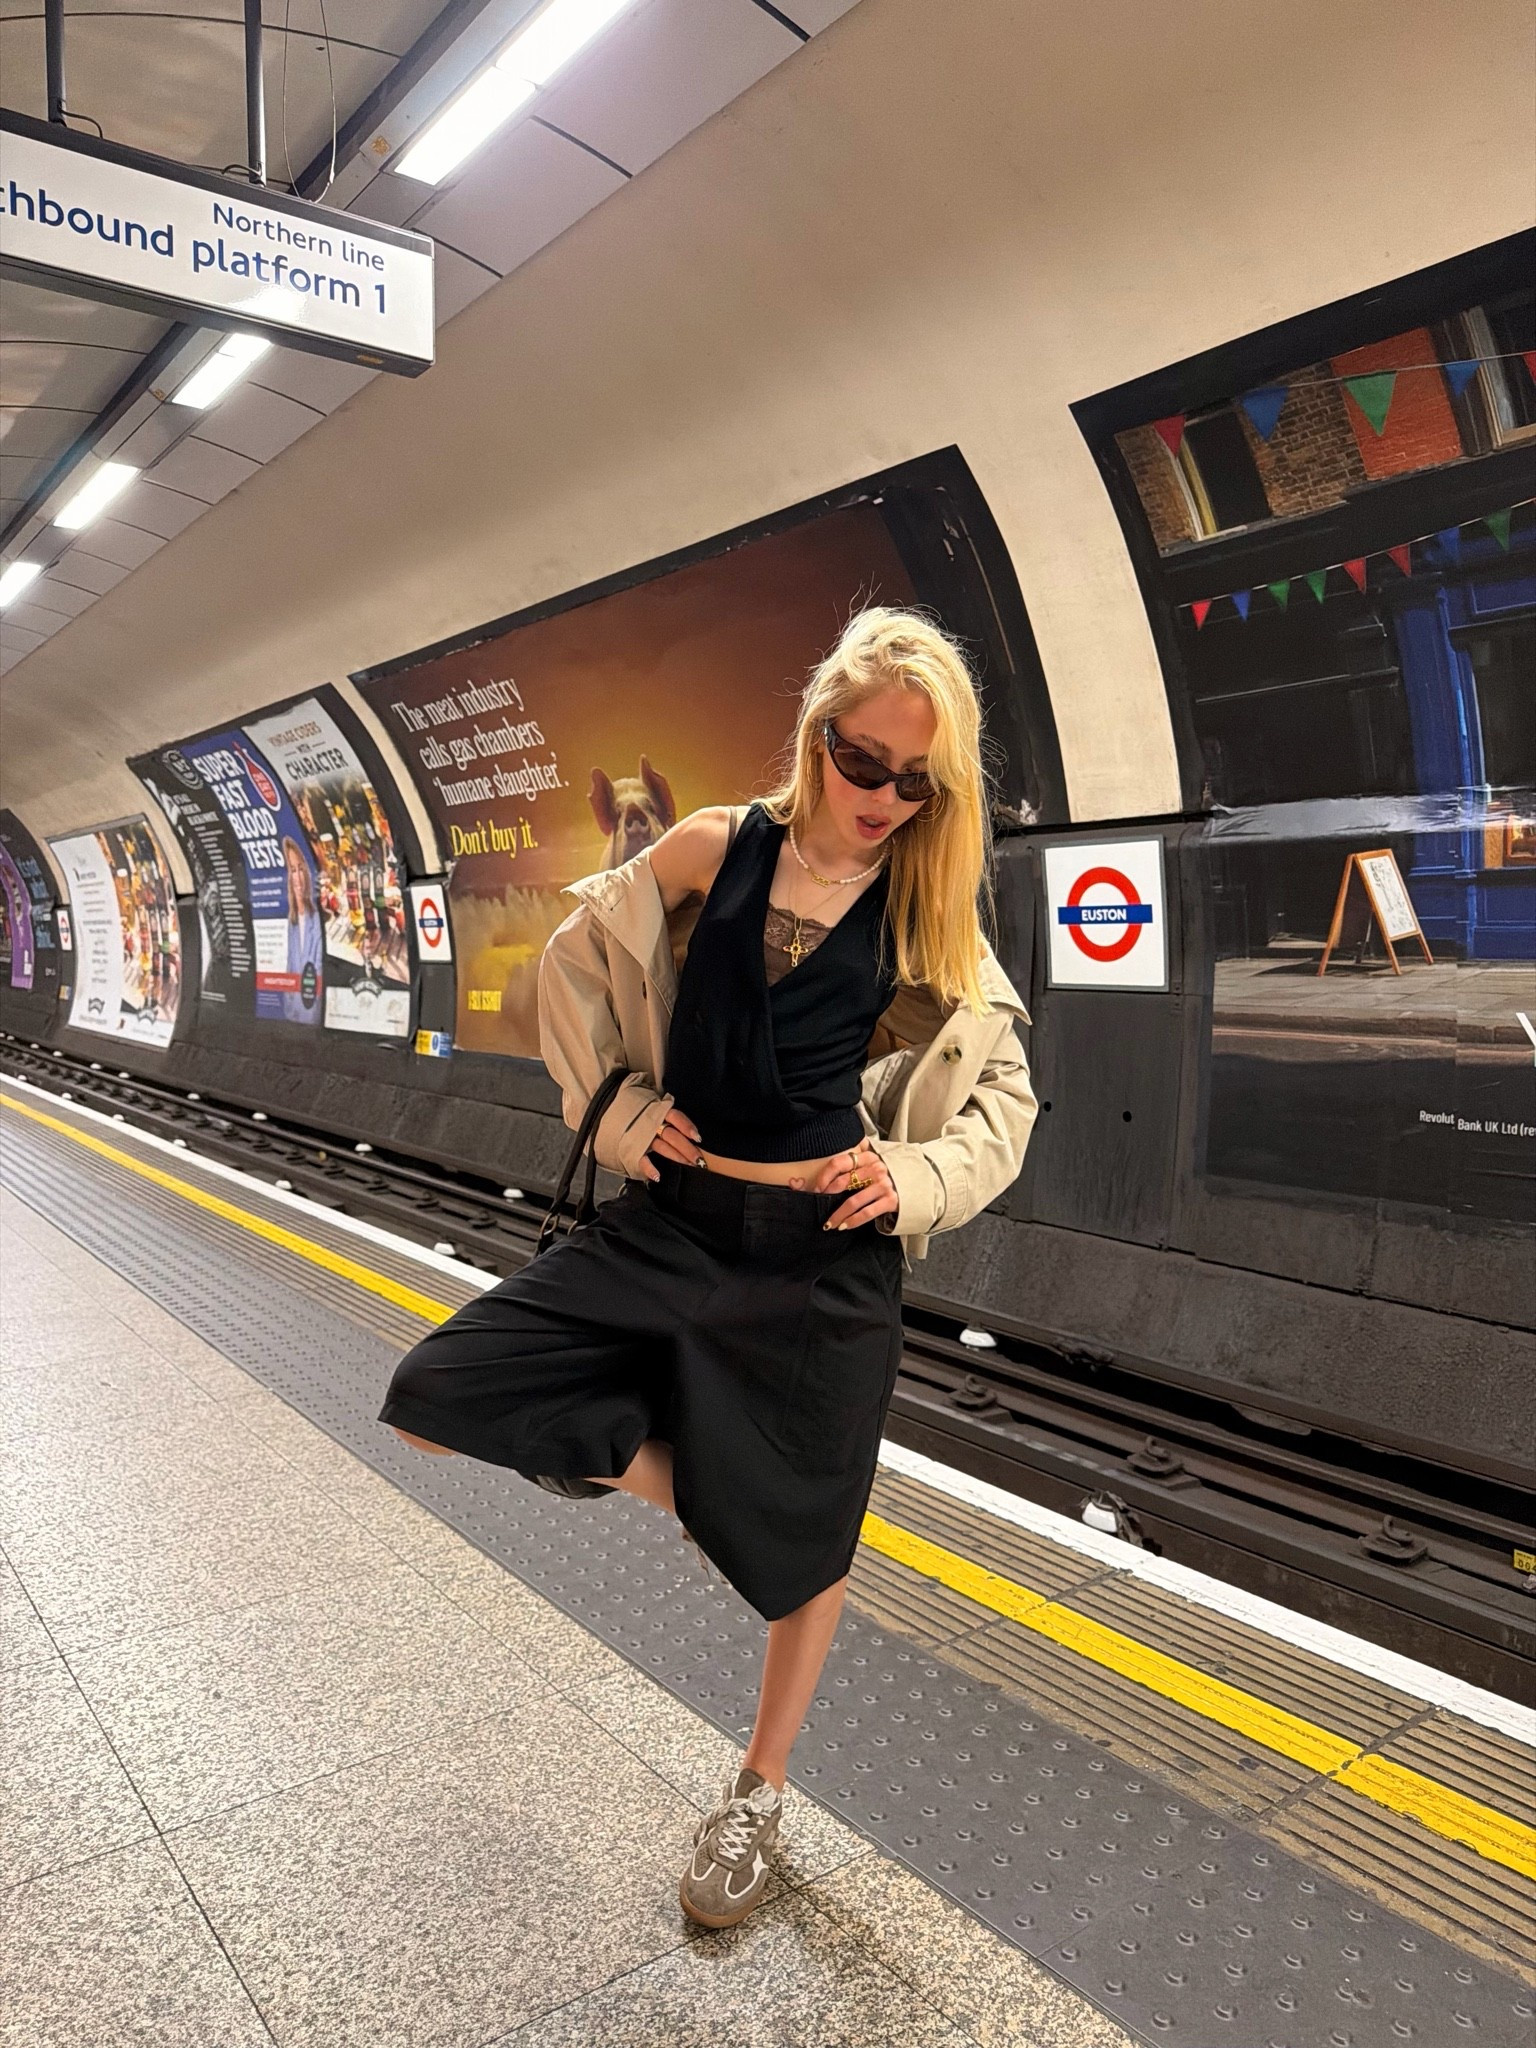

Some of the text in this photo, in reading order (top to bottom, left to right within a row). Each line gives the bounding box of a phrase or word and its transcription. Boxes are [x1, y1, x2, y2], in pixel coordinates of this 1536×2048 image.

[213, 202, 386, 272] Northern line
[192, 238, 361, 308] platform
[374, 284, 387, 314] 1
[391, 678, 525, 733] The meat industry
[419, 716, 545, 771] calls gas chambers
[191, 749, 245, 783] SUPER
[285, 747, 349, 781] CHARACTER
[211, 779, 251, 811] FAST
[227, 807, 277, 840] BLOOD
[450, 816, 538, 859] Don't buy it.
[241, 838, 285, 870] TESTS
[1081, 908, 1127, 921] EUSTON
[1419, 1110, 1536, 1137] Revolut Bank UK Ltd (re
